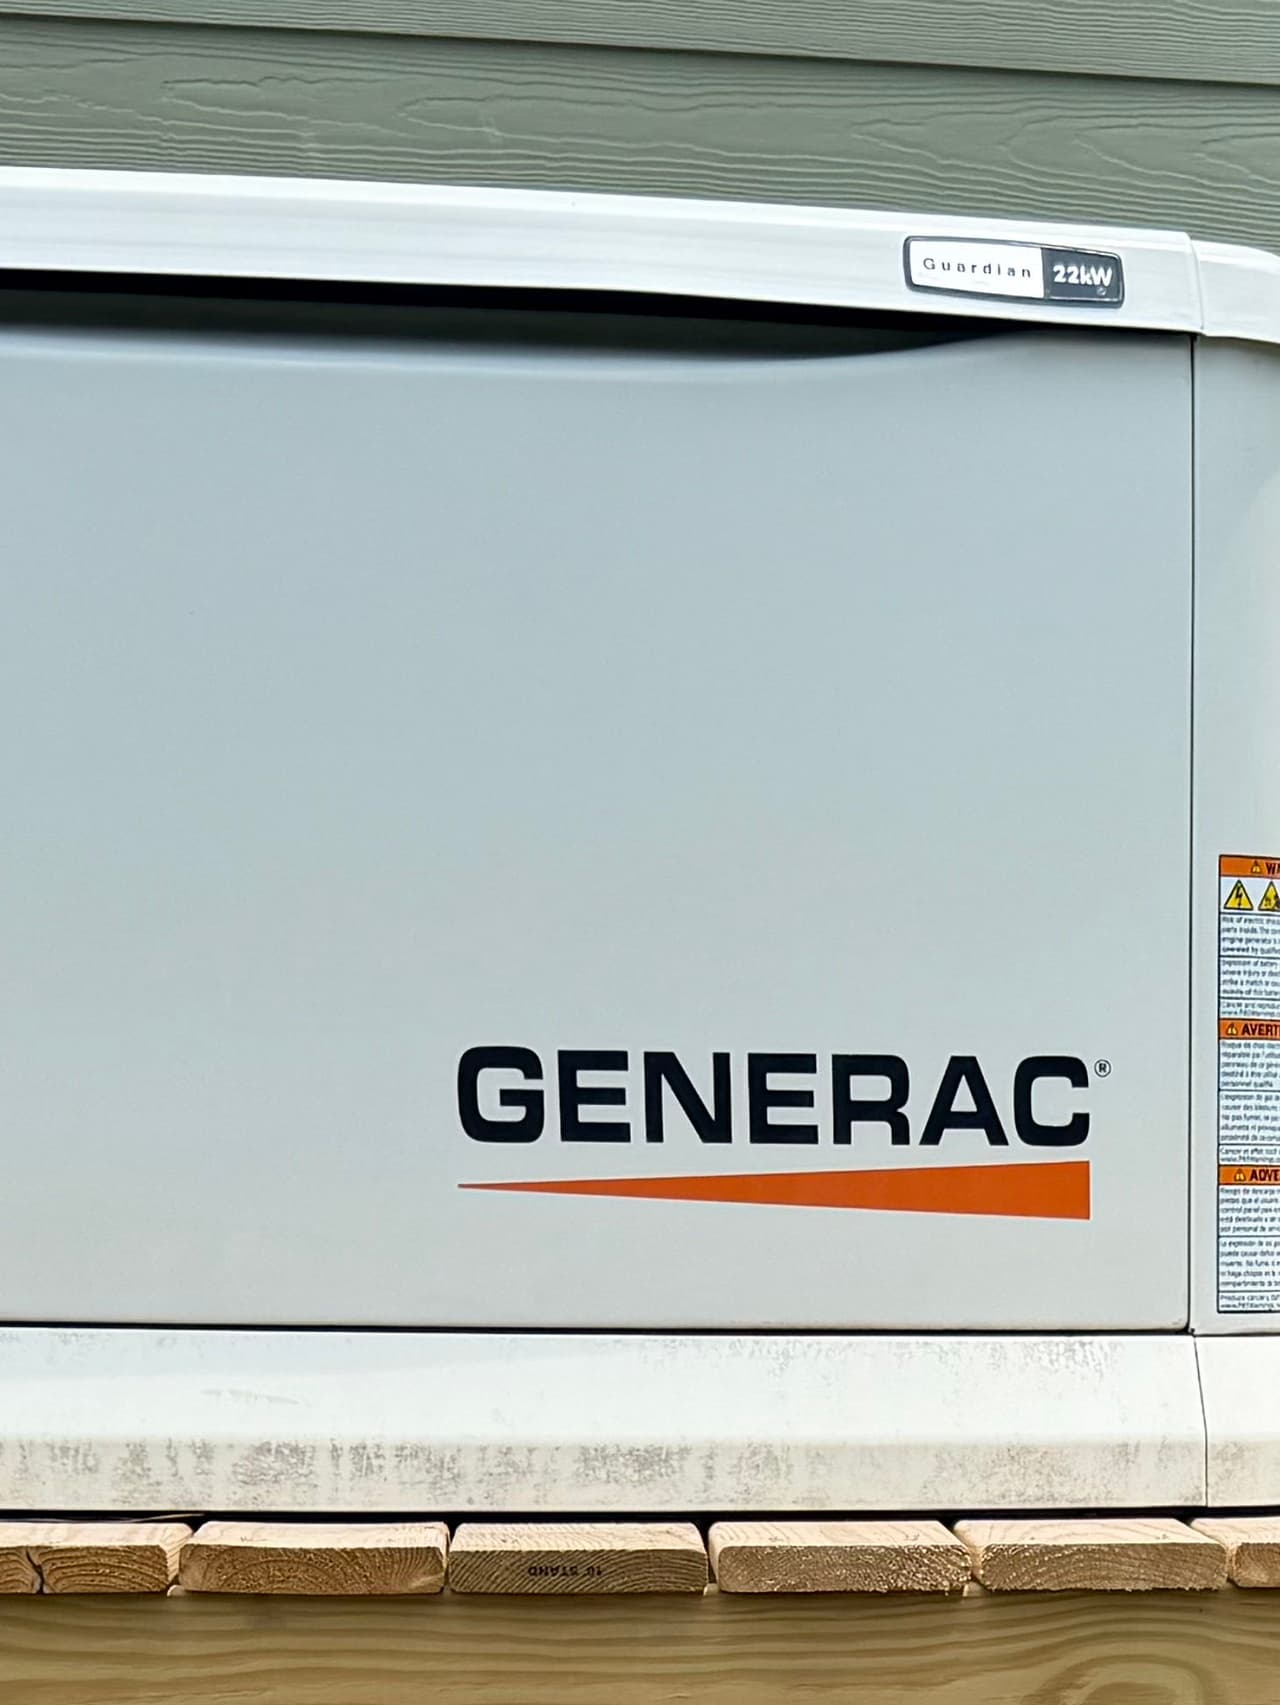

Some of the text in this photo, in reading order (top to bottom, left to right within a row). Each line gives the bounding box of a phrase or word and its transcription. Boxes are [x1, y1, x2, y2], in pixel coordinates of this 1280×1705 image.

[922, 257, 1113, 287] Guardian 22kW
[457, 1045, 1091, 1147] GENERAC
